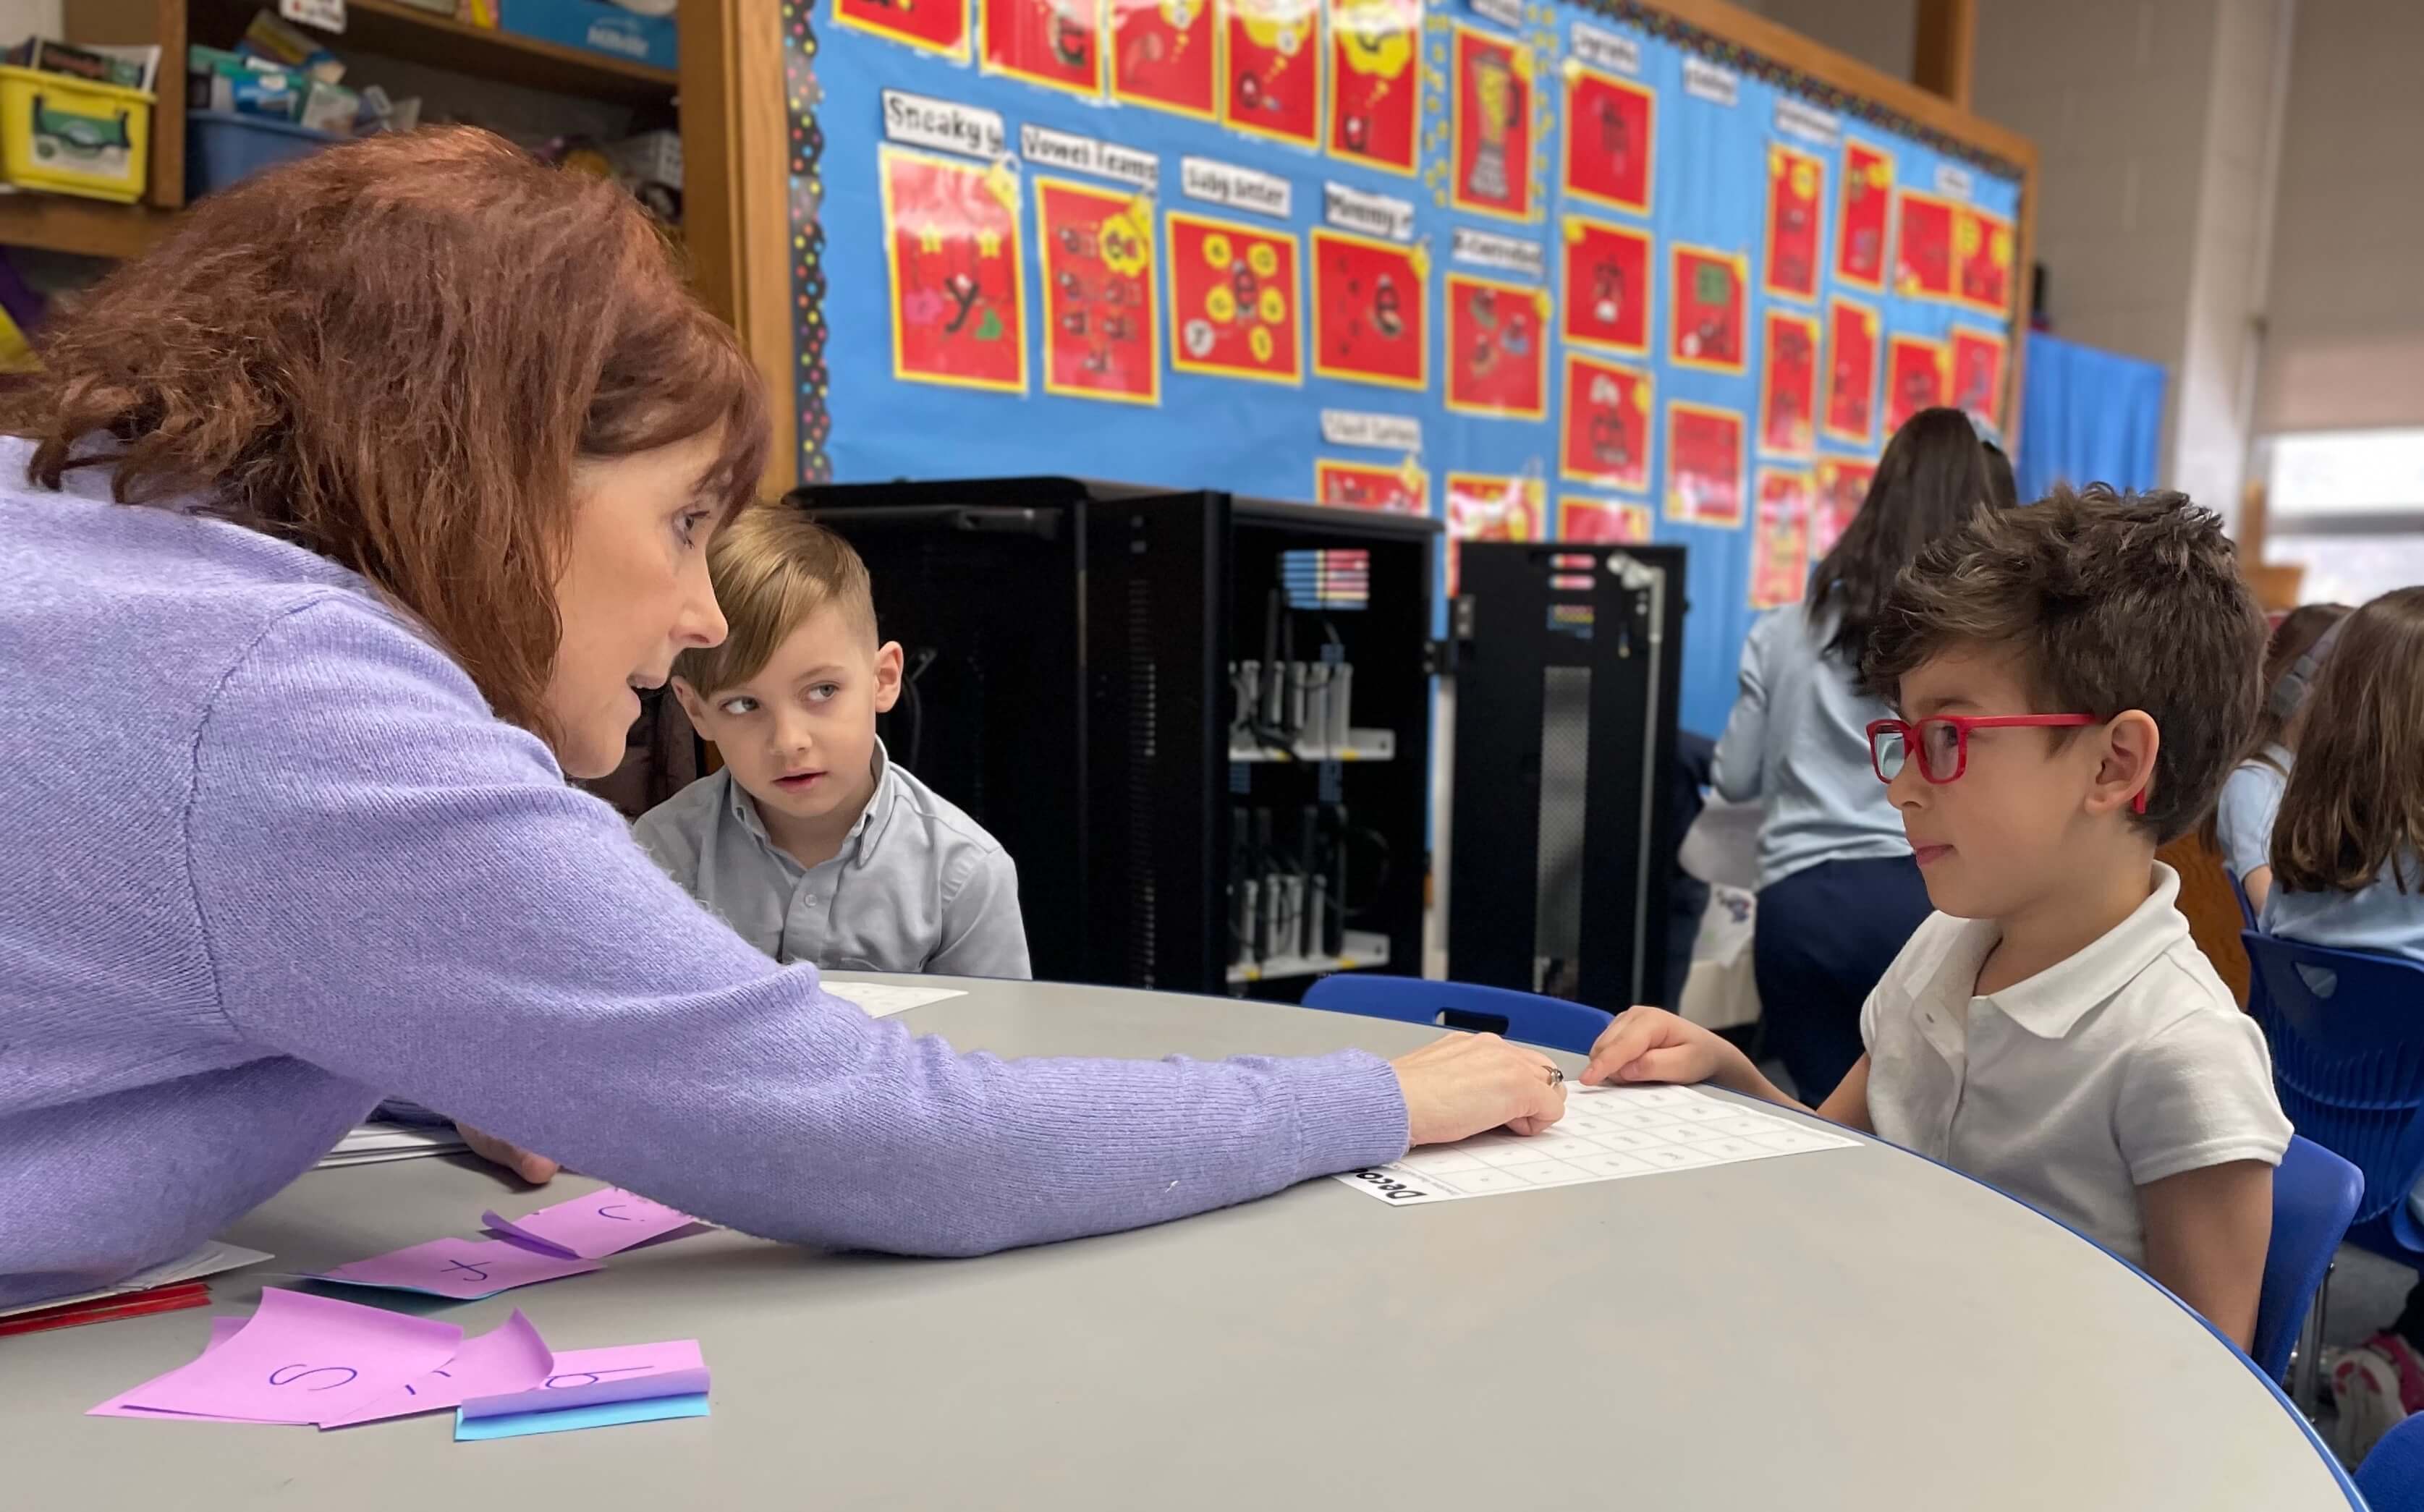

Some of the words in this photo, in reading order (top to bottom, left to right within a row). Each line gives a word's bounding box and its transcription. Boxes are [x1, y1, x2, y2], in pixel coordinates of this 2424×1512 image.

[889, 97, 980, 148] Sneaky
[1024, 129, 1087, 161] Vowel
[1095, 142, 1157, 179] Teams
